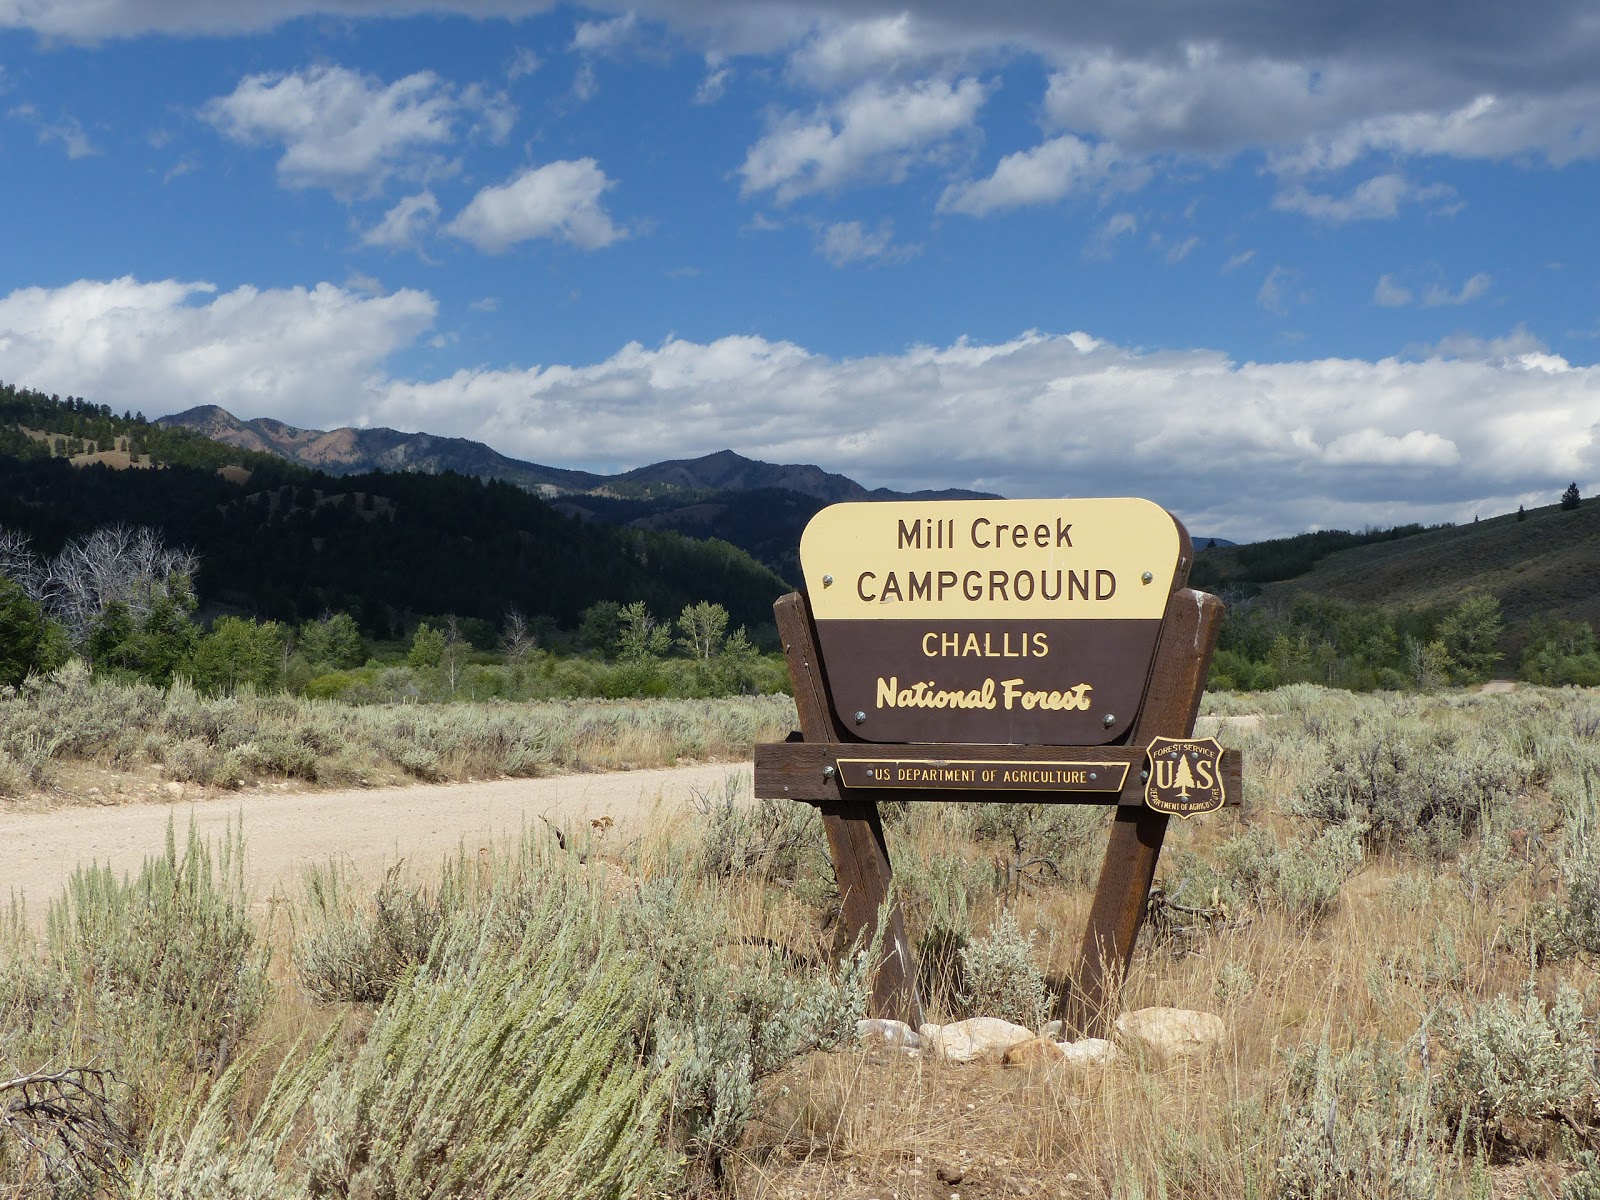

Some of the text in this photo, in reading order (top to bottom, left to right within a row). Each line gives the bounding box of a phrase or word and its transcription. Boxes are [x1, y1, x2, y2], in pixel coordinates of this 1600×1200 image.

[898, 517, 1074, 549] Mill Creek
[857, 569, 1117, 602] CAMPGROUND
[922, 631, 1049, 657] CHALLIS
[876, 676, 1093, 711] National Forest
[1153, 743, 1216, 759] FOREST SERVICE
[898, 768, 976, 782] DEPARTMENT
[982, 769, 997, 782] OF
[1003, 770, 1087, 784] AGRICULTURE
[1150, 787, 1179, 810] DEPARTMENT
[1180, 803, 1188, 811] OF
